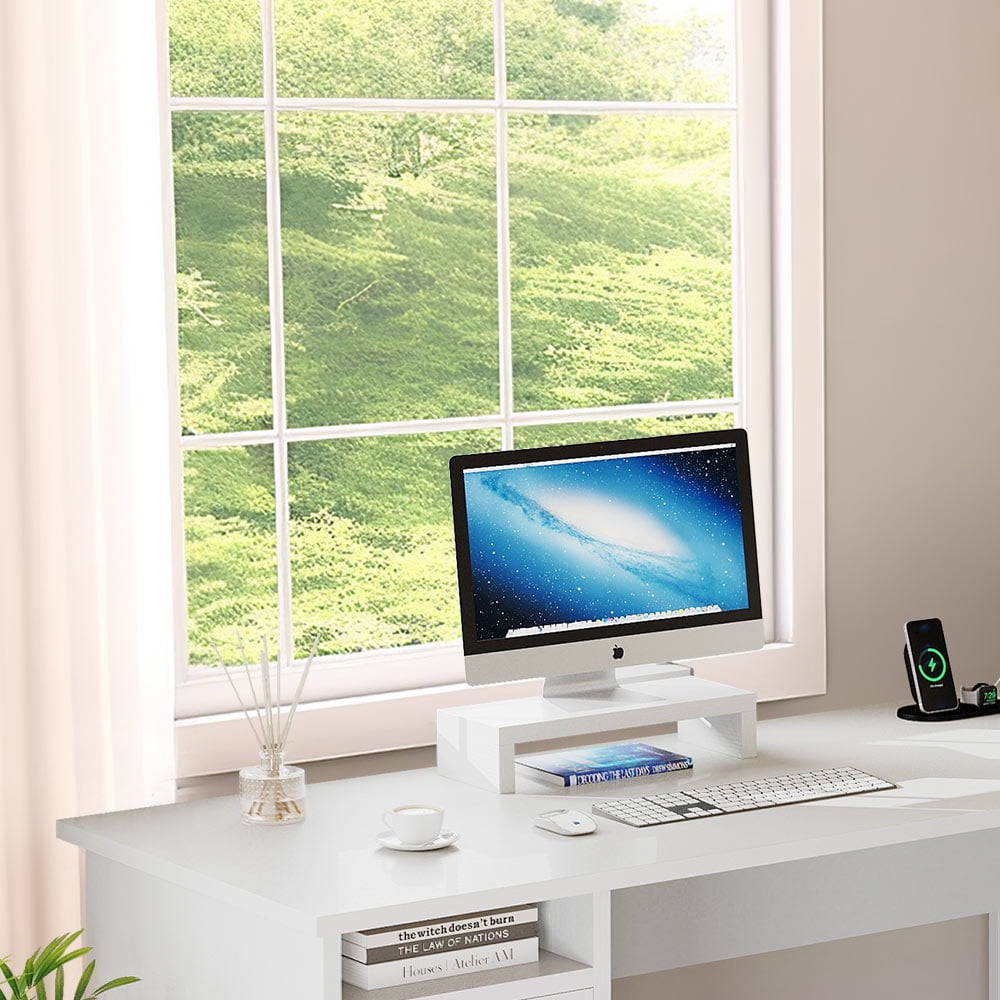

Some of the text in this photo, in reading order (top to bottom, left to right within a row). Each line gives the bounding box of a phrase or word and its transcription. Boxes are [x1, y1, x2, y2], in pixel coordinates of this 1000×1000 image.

[398, 931, 417, 941] the
[417, 925, 448, 938] witch
[489, 915, 515, 926] burn
[398, 929, 510, 956] THE LAW OF NATIONS
[403, 964, 443, 978] Houses
[455, 954, 489, 968] Atelier
